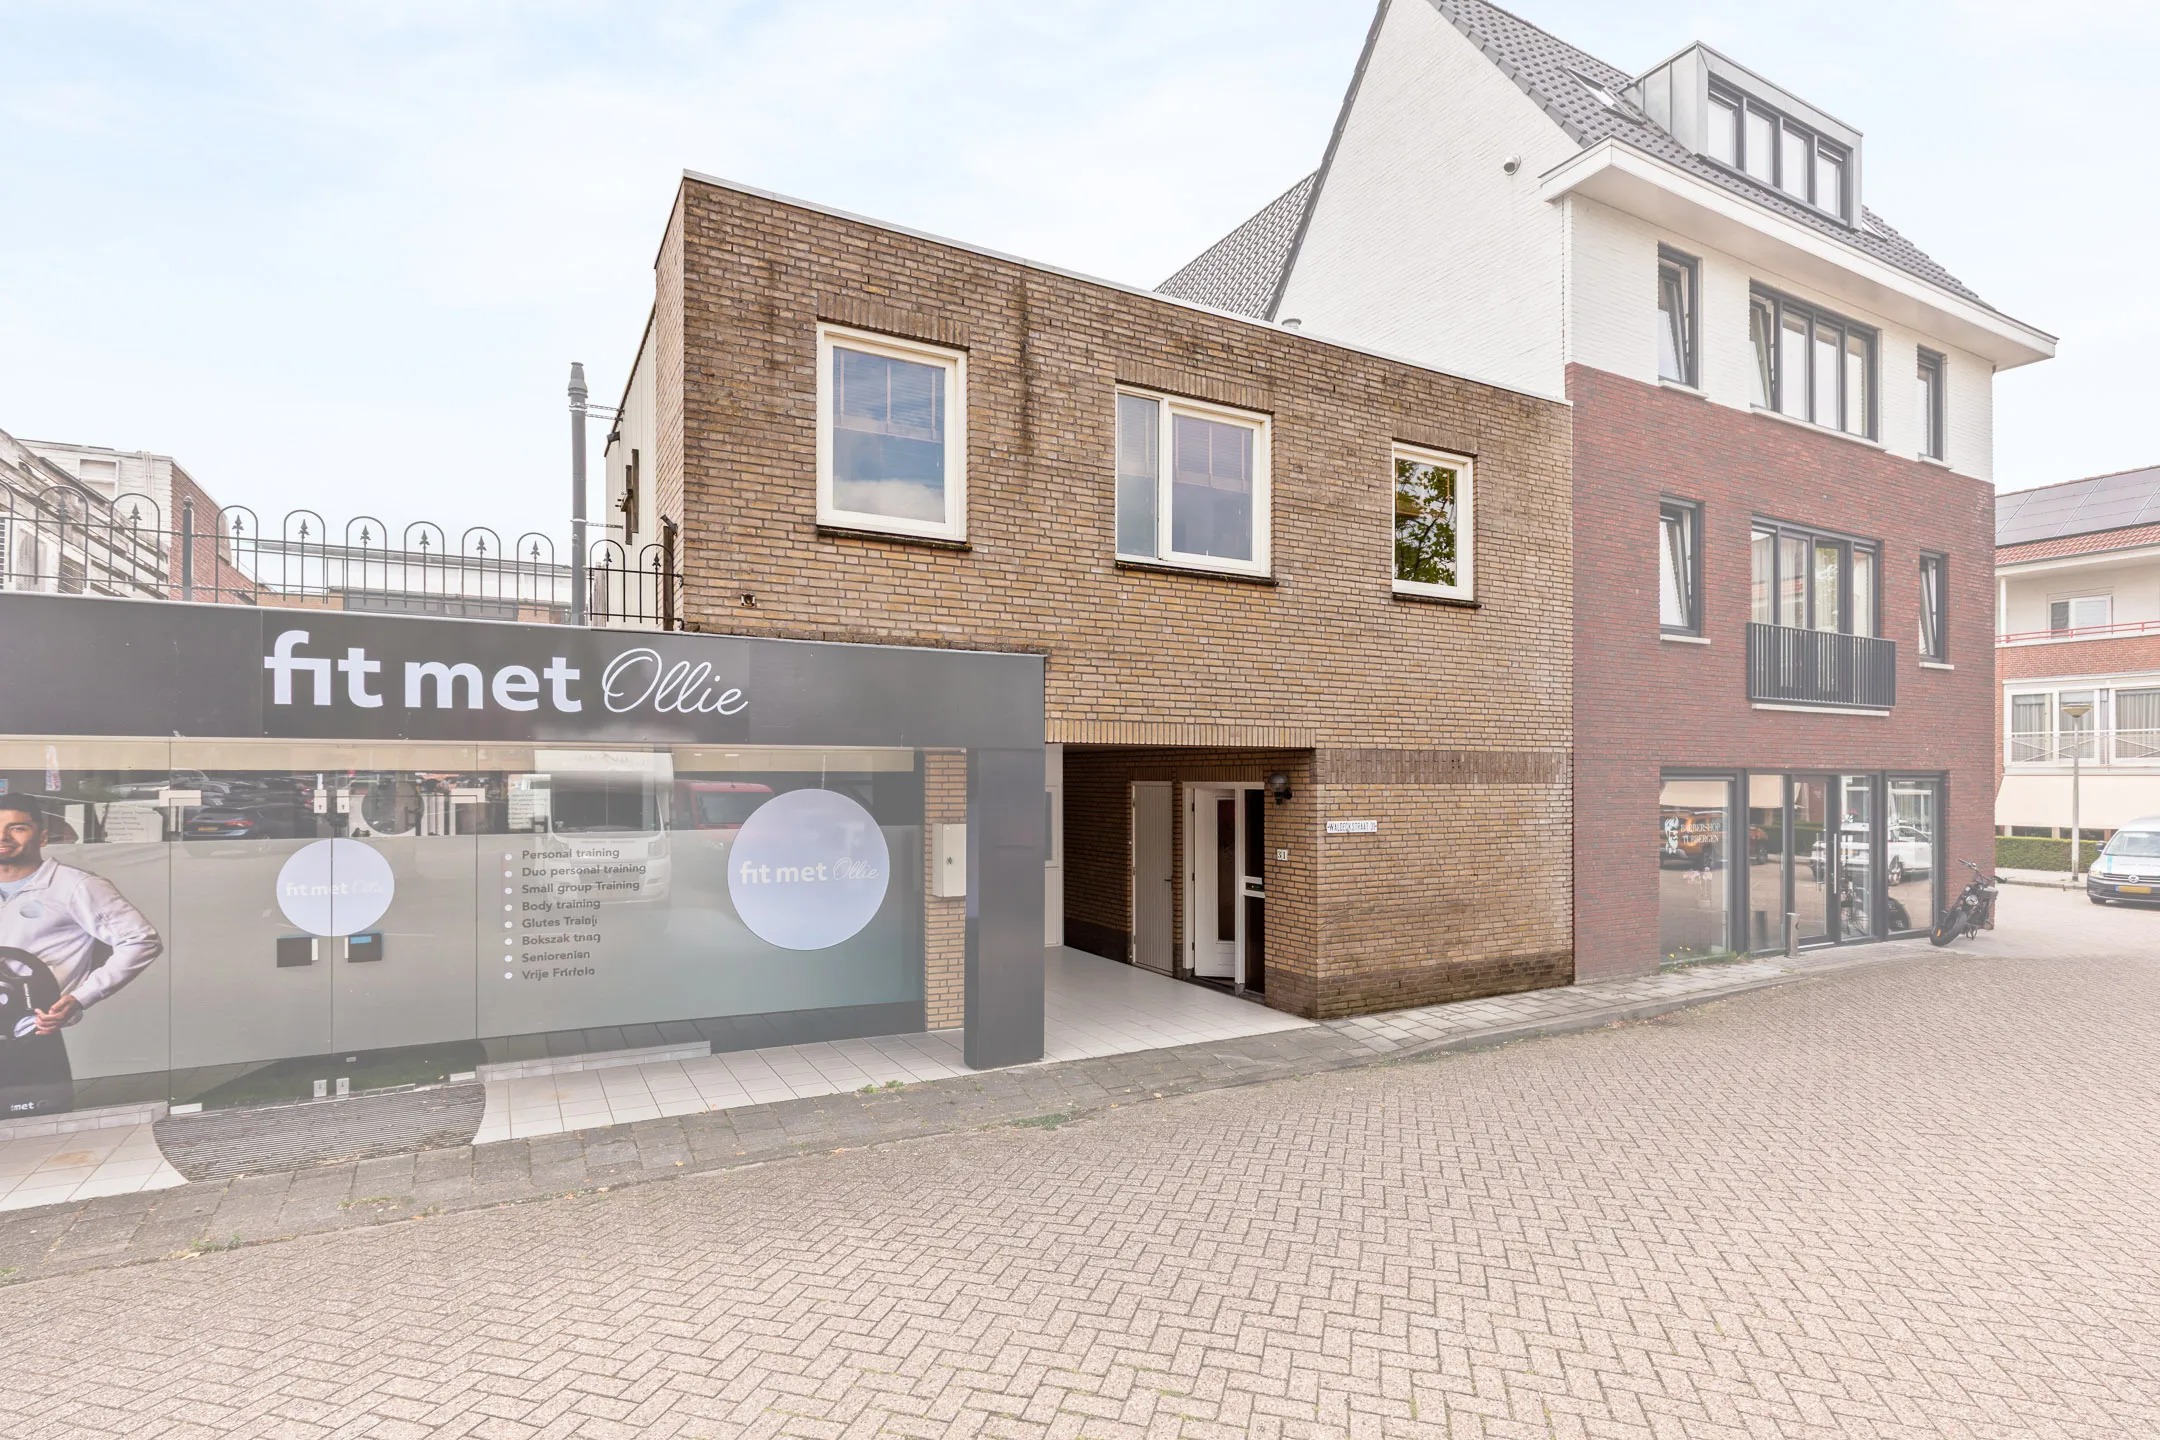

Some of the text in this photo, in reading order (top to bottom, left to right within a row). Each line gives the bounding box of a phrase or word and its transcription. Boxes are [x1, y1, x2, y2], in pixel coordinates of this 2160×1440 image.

[264, 629, 748, 716] fit met Ollie
[522, 848, 620, 860] Personal training
[1277, 851, 1286, 859] 31
[522, 864, 646, 878] Duo personal training
[740, 857, 879, 884] fit met Ollie
[521, 881, 640, 895] Small group Training
[522, 900, 601, 912] Body training
[521, 918, 561, 929] Glutes
[522, 934, 570, 945] Bokszak
[521, 969, 549, 982] Vrije
